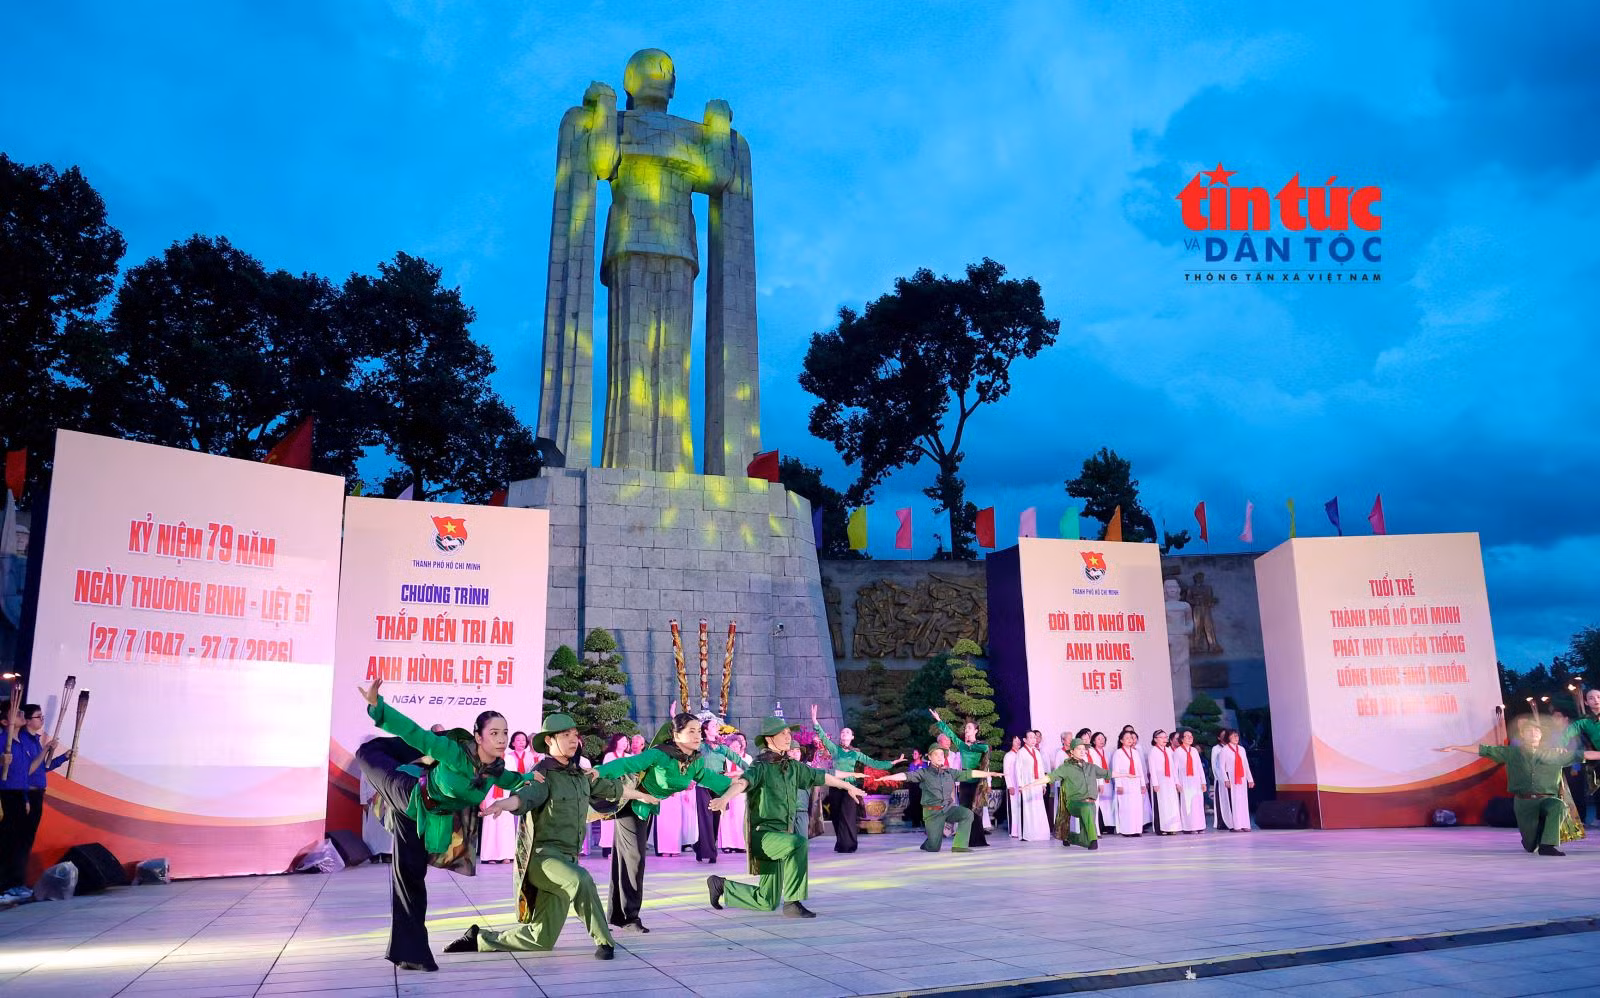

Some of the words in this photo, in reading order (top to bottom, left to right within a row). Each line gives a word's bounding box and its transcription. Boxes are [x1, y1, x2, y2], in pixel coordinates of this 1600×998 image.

[129, 512, 154, 553] KỶ
[156, 521, 203, 565] NIỆM
[206, 523, 234, 564] 79
[235, 530, 276, 567] NĂM
[401, 583, 450, 604] CHƯƠNG
[454, 584, 489, 605] TRÌNH
[1369, 571, 1394, 597] TUỔI
[1395, 572, 1415, 597] TRẺ
[74, 567, 127, 606] NGÀY
[131, 576, 201, 613] THƯƠNG
[204, 583, 246, 617] BINH
[261, 586, 291, 627] LIỆT
[295, 589, 312, 623] SĨ
[376, 608, 417, 640] THẮP
[422, 611, 456, 642] NẾN
[462, 619, 486, 643] TRI
[490, 617, 513, 644] ÂN
[1049, 611, 1070, 631] ĐỜI
[1074, 611, 1095, 631] ĐỜI
[1098, 612, 1125, 632] NHỚ
[1127, 613, 1146, 632] ƠN
[1330, 606, 1366, 627] THÀNH
[1369, 603, 1391, 626] PHỐ
[1410, 605, 1428, 625] CHÍ
[1430, 606, 1461, 624] MINH
[1066, 643, 1092, 661] ANH
[1096, 640, 1134, 661] HÙNG,
[1333, 636, 1360, 656] PHÁT
[1363, 638, 1383, 656] HUY
[1429, 631, 1466, 654] THỐNG
[366, 656, 402, 681] ANH
[407, 654, 457, 684] HÙNG,
[462, 656, 493, 689] LIỆT
[497, 657, 514, 684] SĨ
[1083, 669, 1105, 694] LIỆT
[1110, 669, 1122, 690] SĨ
[392, 694, 424, 704] NGÀY
[429, 696, 487, 706] 26/7/2026
